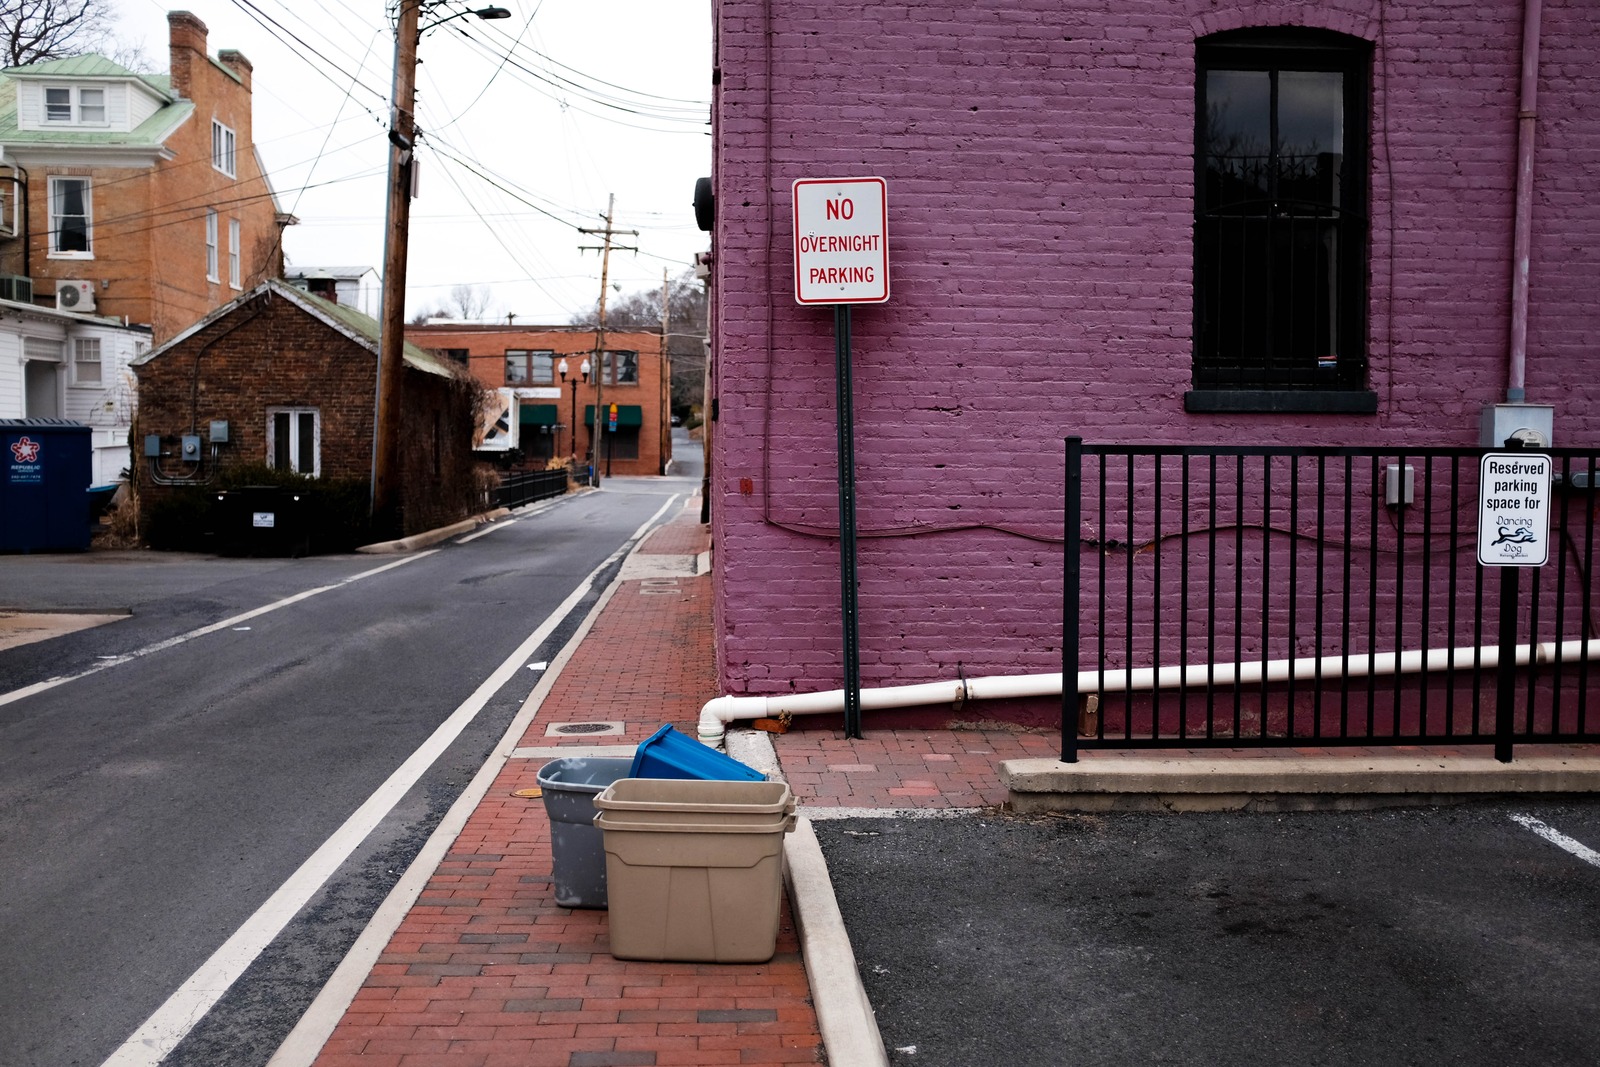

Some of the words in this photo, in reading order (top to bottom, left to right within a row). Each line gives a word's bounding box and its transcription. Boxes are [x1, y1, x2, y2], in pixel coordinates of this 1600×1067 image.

[826, 198, 854, 220] NO
[800, 234, 880, 253] OVERNIGHT
[810, 266, 874, 284] PARKING
[1489, 461, 1544, 475] Reserved
[1494, 479, 1538, 495] parking
[1486, 498, 1521, 511] space
[1524, 497, 1541, 509] for
[1496, 515, 1533, 528] Dancing
[1503, 543, 1522, 555] Dog
